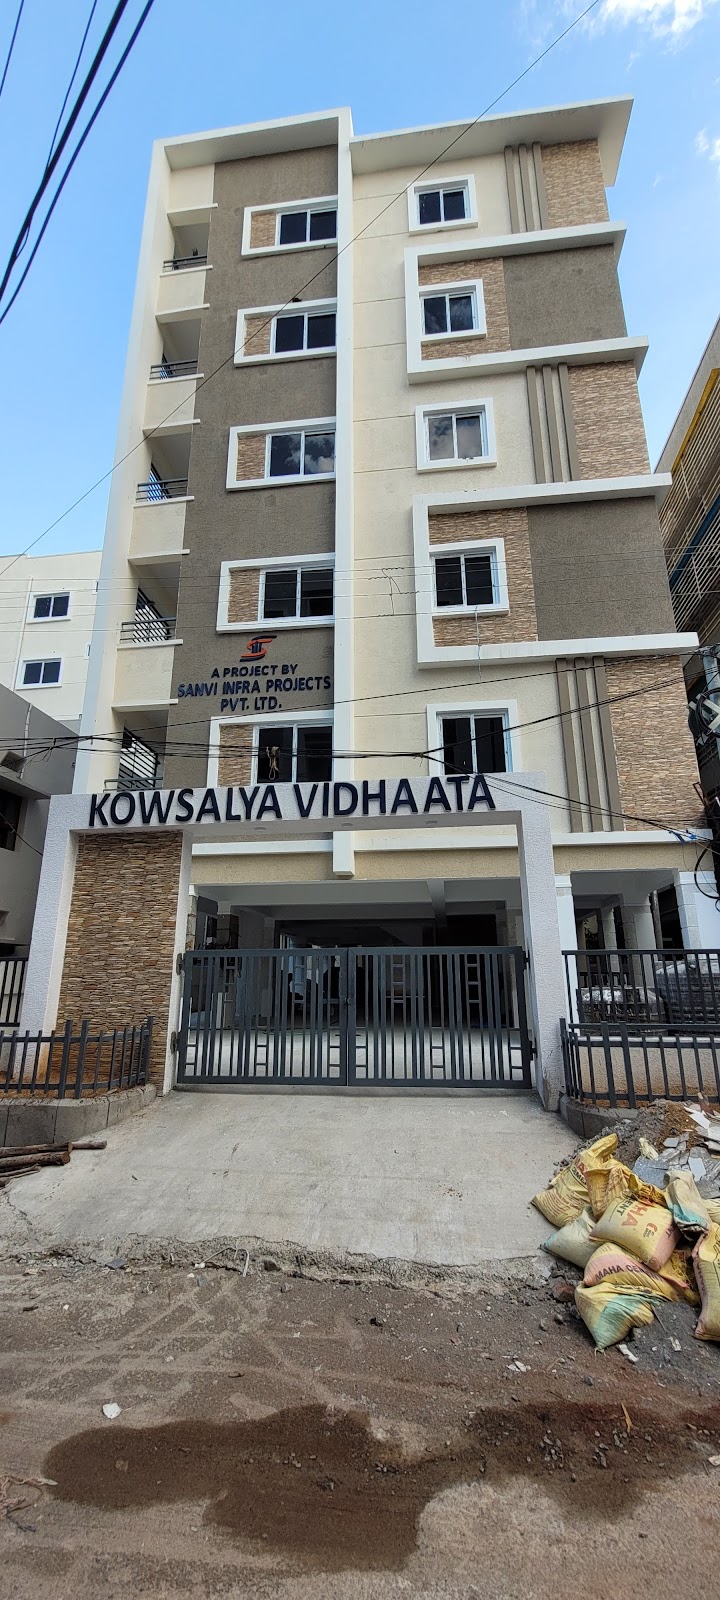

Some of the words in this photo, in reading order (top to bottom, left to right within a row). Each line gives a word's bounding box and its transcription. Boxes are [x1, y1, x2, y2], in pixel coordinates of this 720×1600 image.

[211, 667, 220, 678] A
[223, 665, 278, 677] PROJECT
[281, 664, 298, 675] BY
[177, 682, 218, 697] SANVI
[222, 680, 260, 695] INFRA
[266, 675, 331, 693] PROJECTS
[220, 698, 250, 712] PVT.
[254, 696, 282, 710] LTD.
[88, 784, 283, 827] KOWSALYA
[293, 774, 497, 818] VIDHAATA
[594, 1264, 625, 1282] MAHA
